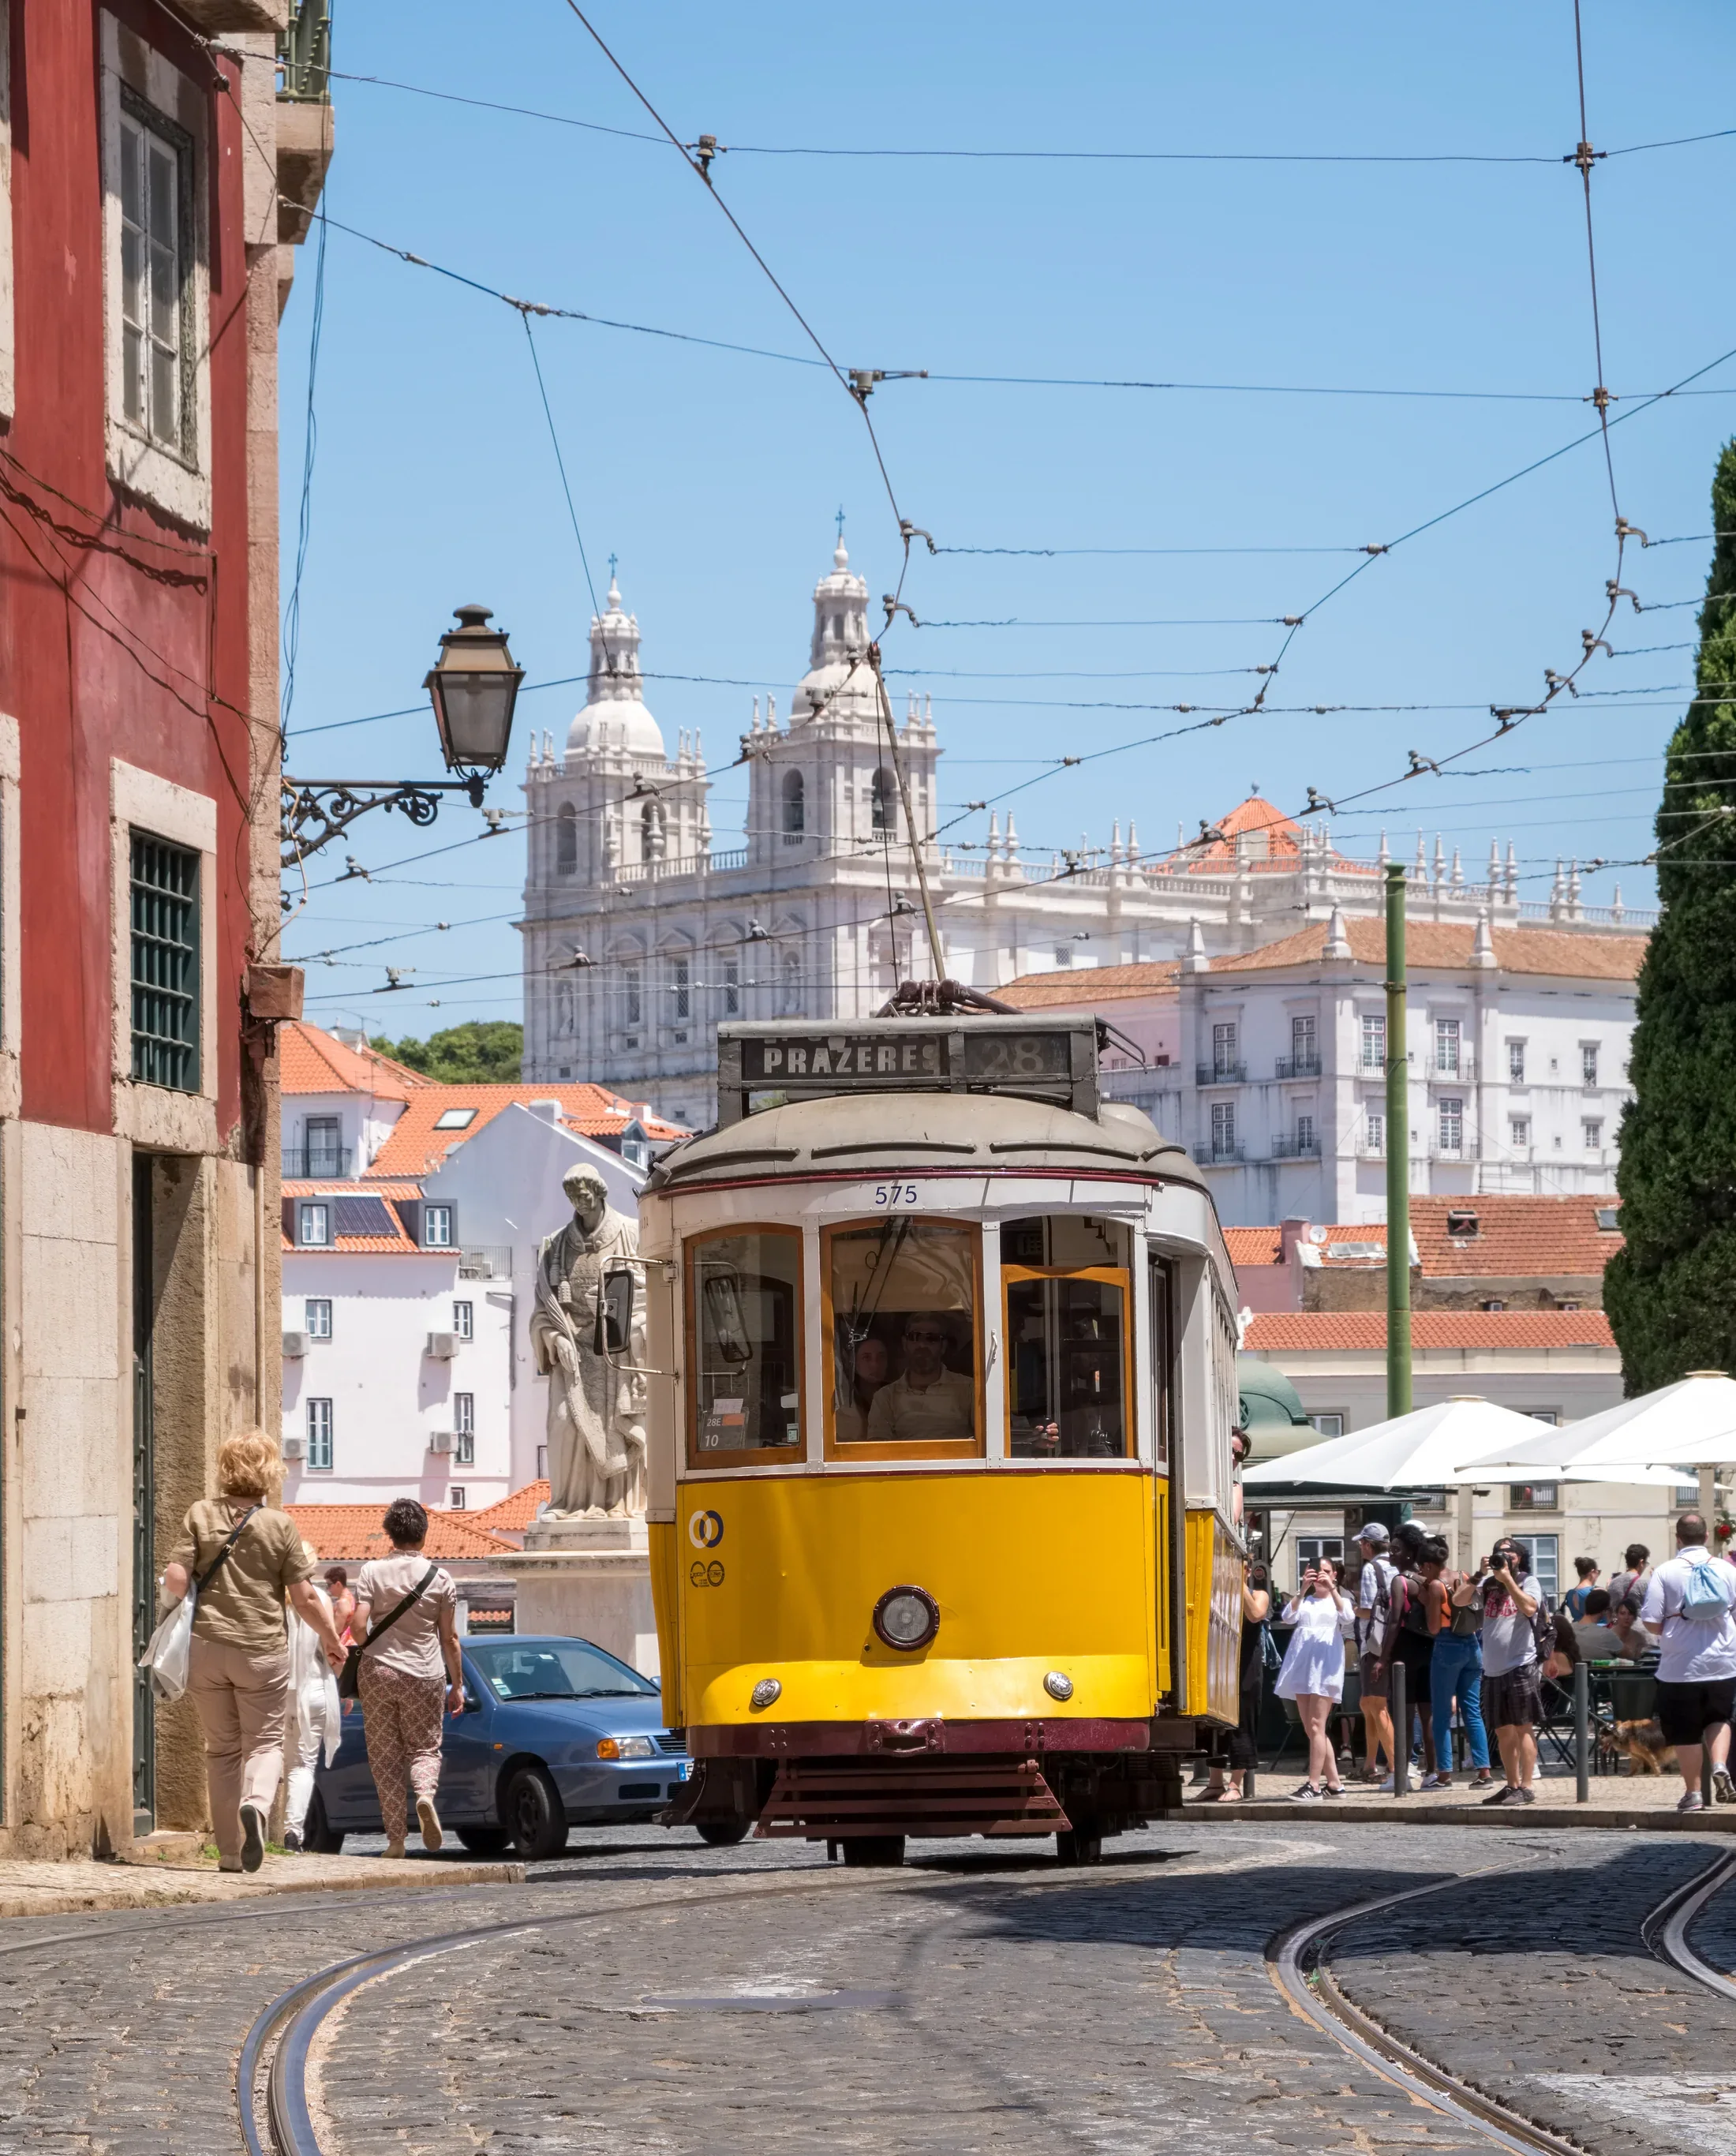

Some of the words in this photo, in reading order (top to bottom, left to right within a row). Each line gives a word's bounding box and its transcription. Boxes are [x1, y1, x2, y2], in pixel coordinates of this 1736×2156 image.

[764, 1044, 937, 1073] PRAZERES
[982, 1036, 1044, 1075] 28
[875, 1185, 918, 1204] 575
[706, 1417, 722, 1427] 28E
[705, 1434, 719, 1447] 10
